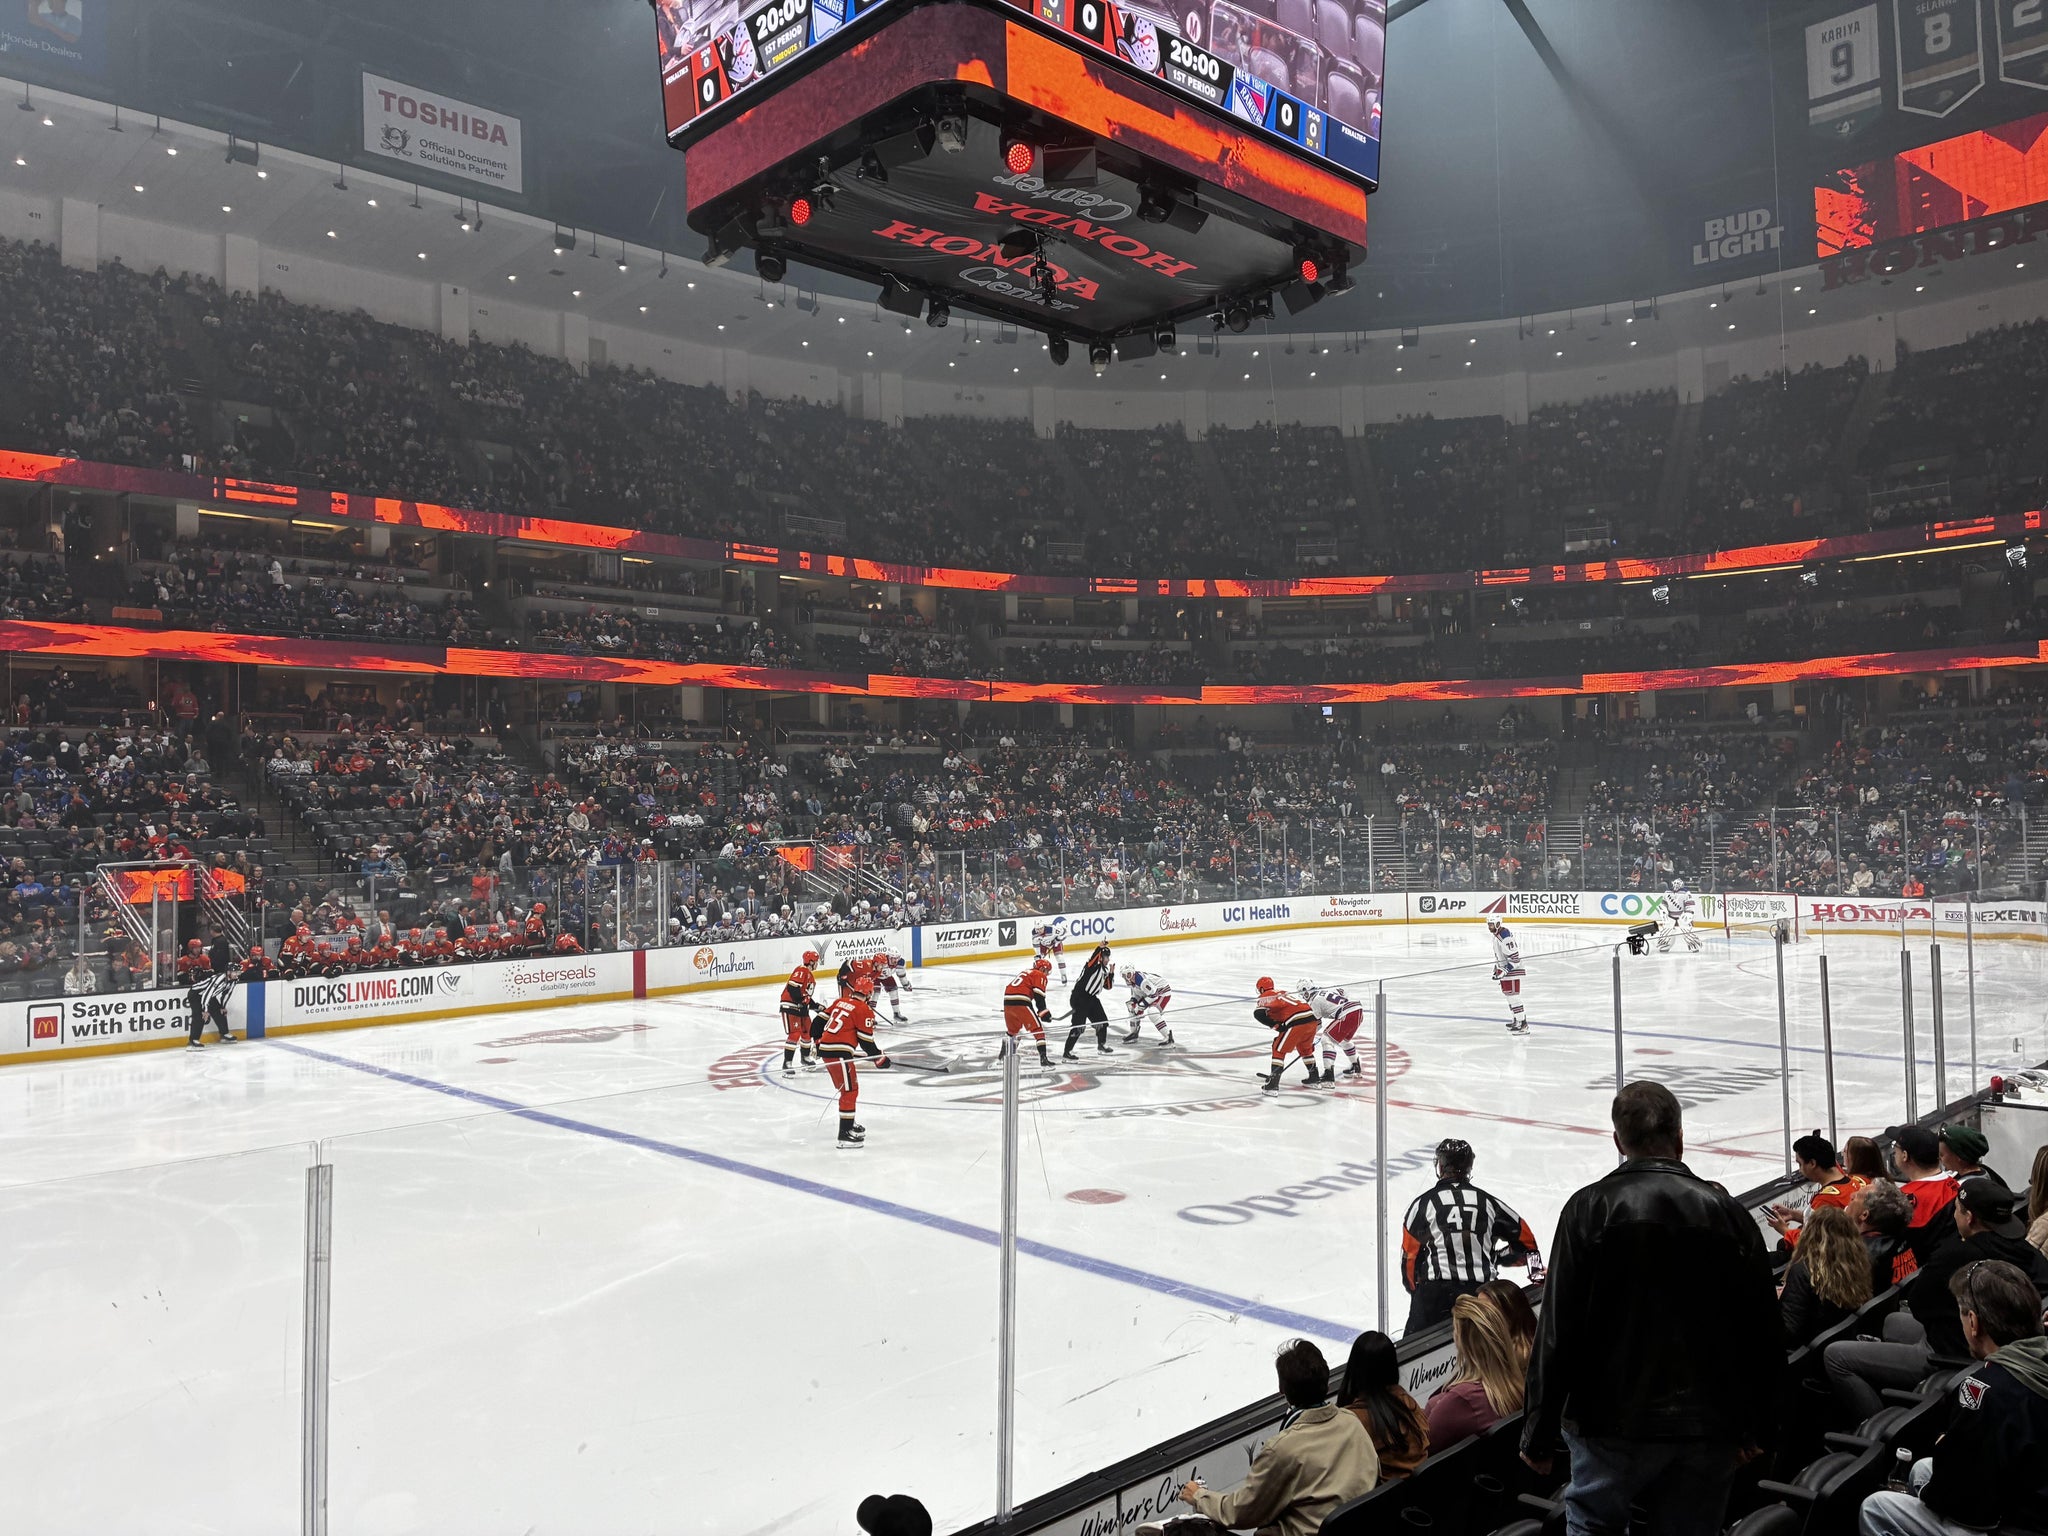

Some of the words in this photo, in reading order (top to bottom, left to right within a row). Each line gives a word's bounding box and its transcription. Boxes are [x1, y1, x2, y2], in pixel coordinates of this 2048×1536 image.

[755, 0, 807, 40] 20:00
[1042, 7, 1053, 18] TO
[1082, 3, 1098, 30] 0
[764, 41, 776, 55] 1ST
[777, 25, 802, 47] PERIOD
[1820, 21, 1861, 44] KARIYA
[1924, 12, 1951, 54] 8
[41, 40, 82, 60] Dealers
[1170, 39, 1220, 81] 20:00
[703, 57, 709, 68] 0
[1830, 41, 1854, 86] 9
[703, 79, 714, 102] 0
[1172, 69, 1186, 84] 1ST
[1187, 76, 1216, 99] PERIOD
[378, 88, 509, 147] TOSHIBA
[1281, 103, 1293, 126] 0
[1307, 110, 1320, 122] SOG
[1309, 122, 1317, 137] 0
[1306, 137, 1313, 147] TO
[419, 138, 456, 157] Official
[457, 149, 508, 171] Document
[419, 150, 467, 171] Solutions
[468, 163, 505, 181] Partner
[972, 192, 1198, 278] HONDA
[1704, 208, 1771, 243] BUD
[1692, 226, 1785, 266] LIGHT
[1338, 897, 1372, 907] Navigator
[1509, 893, 1579, 904] MERCURY
[1509, 905, 1580, 914] INSURANCE
[1600, 893, 1664, 916] COX
[1717, 897, 1787, 912] MONSTER
[1223, 907, 1245, 922] UCI
[1249, 903, 1290, 921] Health
[1320, 908, 1383, 918] ducks.ocnav.org
[1811, 903, 1932, 923] HONDA
[1070, 917, 1115, 936] CHOC
[835, 949, 859, 957] RESORT
[936, 942, 955, 950] STREAM
[514, 964, 596, 984] easterseals
[710, 951, 754, 977] Anaheim
[294, 975, 434, 1008] DUCKSLIVING.COM
[540, 981, 569, 992] disability
[570, 980, 596, 988] services
[72, 1001, 127, 1018] Save
[132, 997, 192, 1013] mone
[305, 1007, 330, 1015] SCORE
[355, 1002, 379, 1010] DREAM
[382, 998, 423, 1007] APARTMENT
[71, 1018, 122, 1037] with
[128, 1015, 165, 1032] the
[170, 1015, 192, 1031] ap
[823, 1008, 850, 1034] 65
[1446, 1205, 1479, 1231] 47
